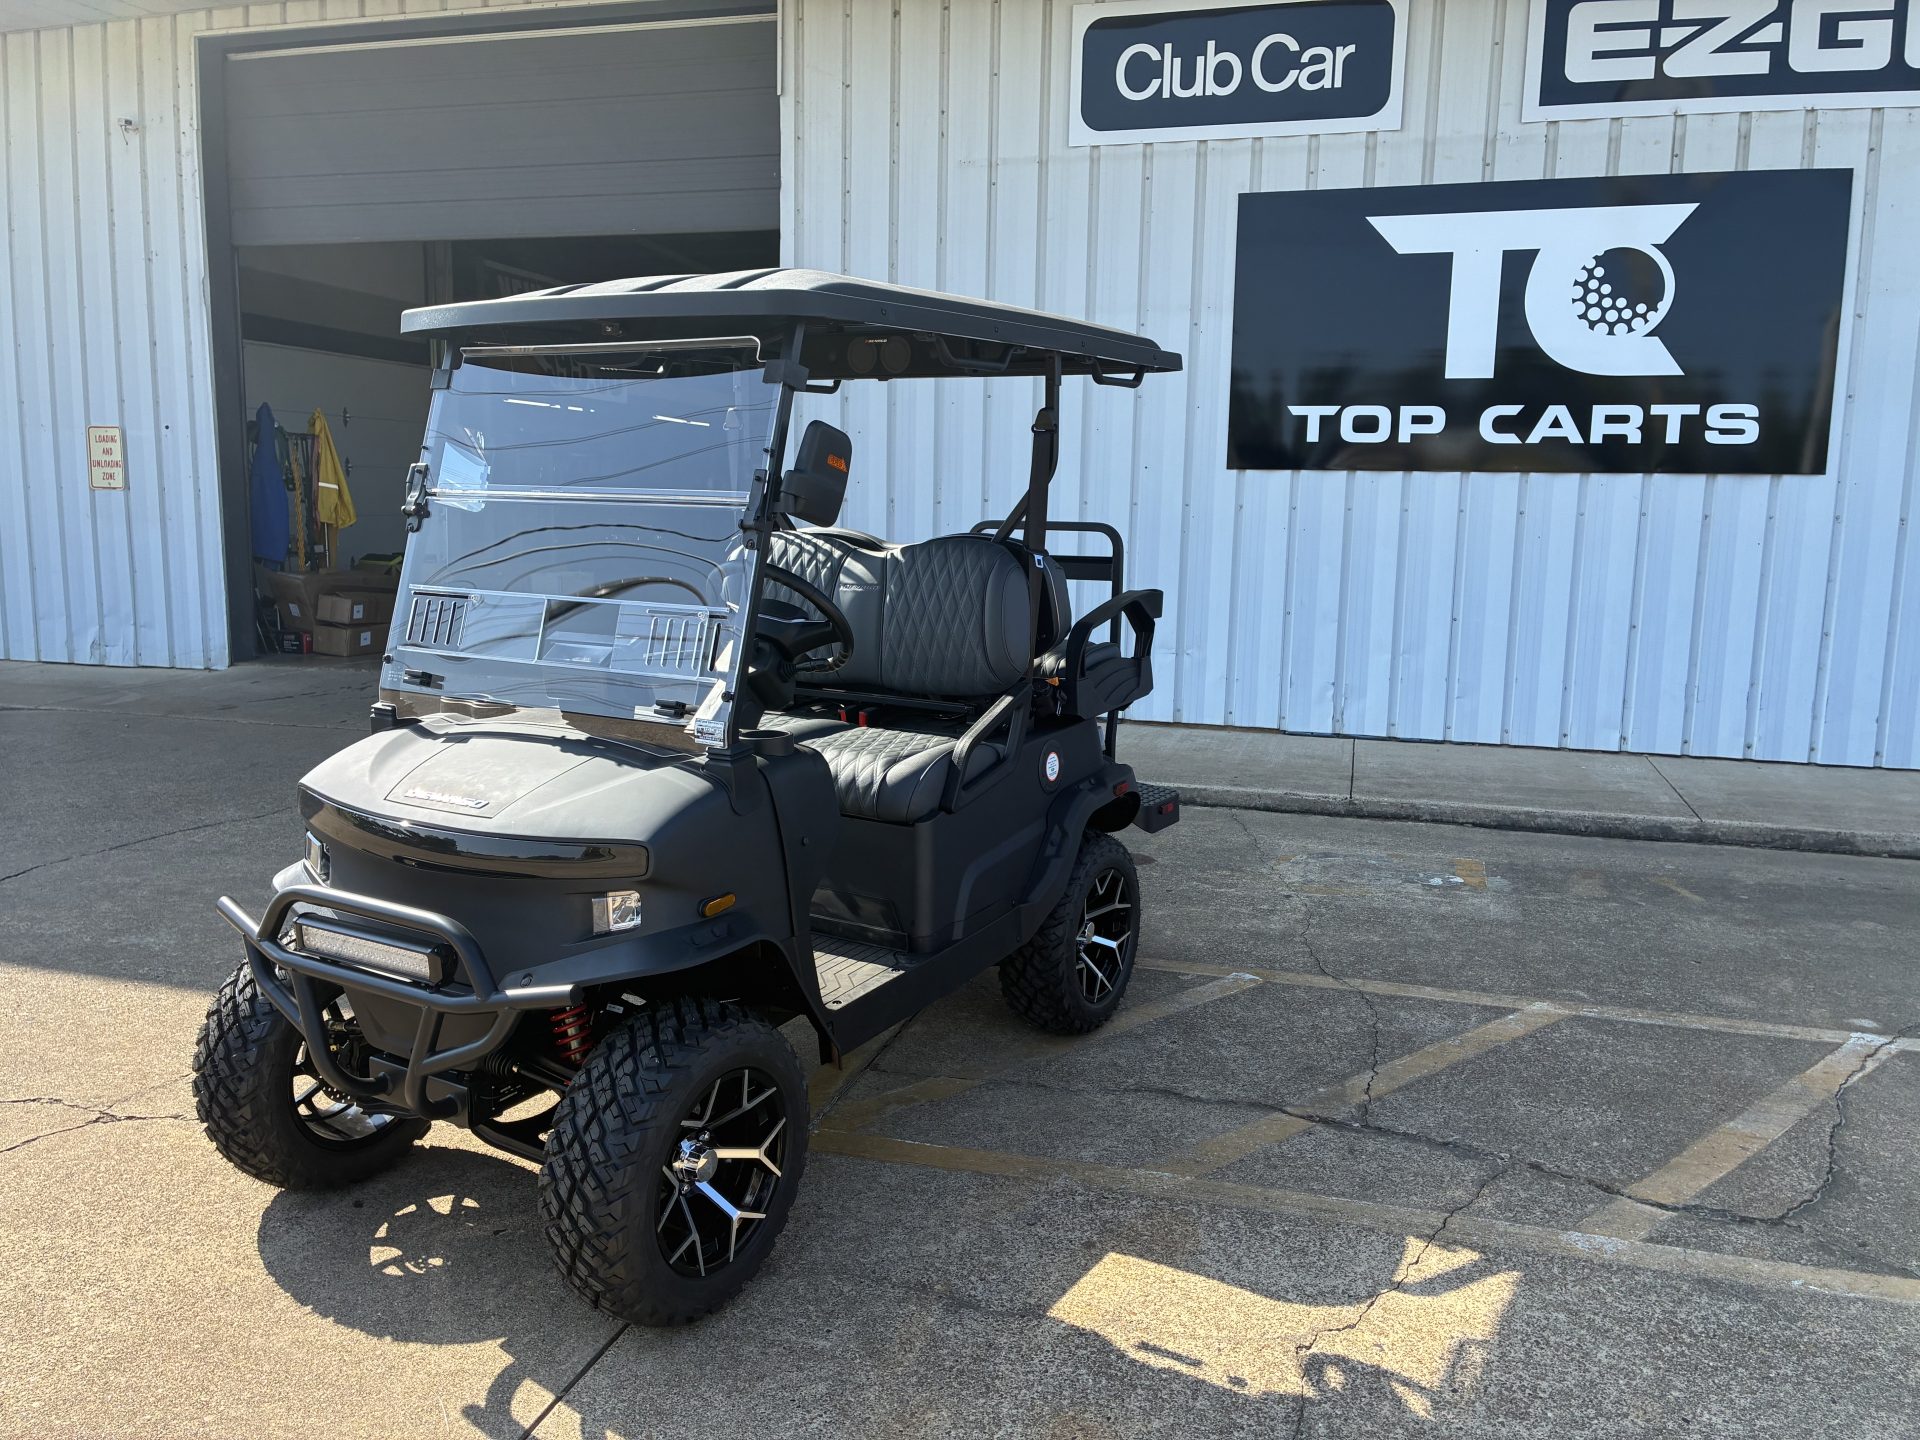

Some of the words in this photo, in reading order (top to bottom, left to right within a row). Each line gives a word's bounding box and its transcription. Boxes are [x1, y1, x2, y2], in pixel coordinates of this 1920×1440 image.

[1565, 0, 1920, 83] EZG
[1115, 40, 1243, 101] Club
[1251, 33, 1356, 93] Car
[1287, 405, 1446, 443] TOP
[1479, 403, 1760, 445] CARTS
[95, 434, 117, 443] LOADING
[102, 447, 113, 456] AND
[92, 460, 122, 468] UNLOADING
[102, 472, 116, 480] ZONE
